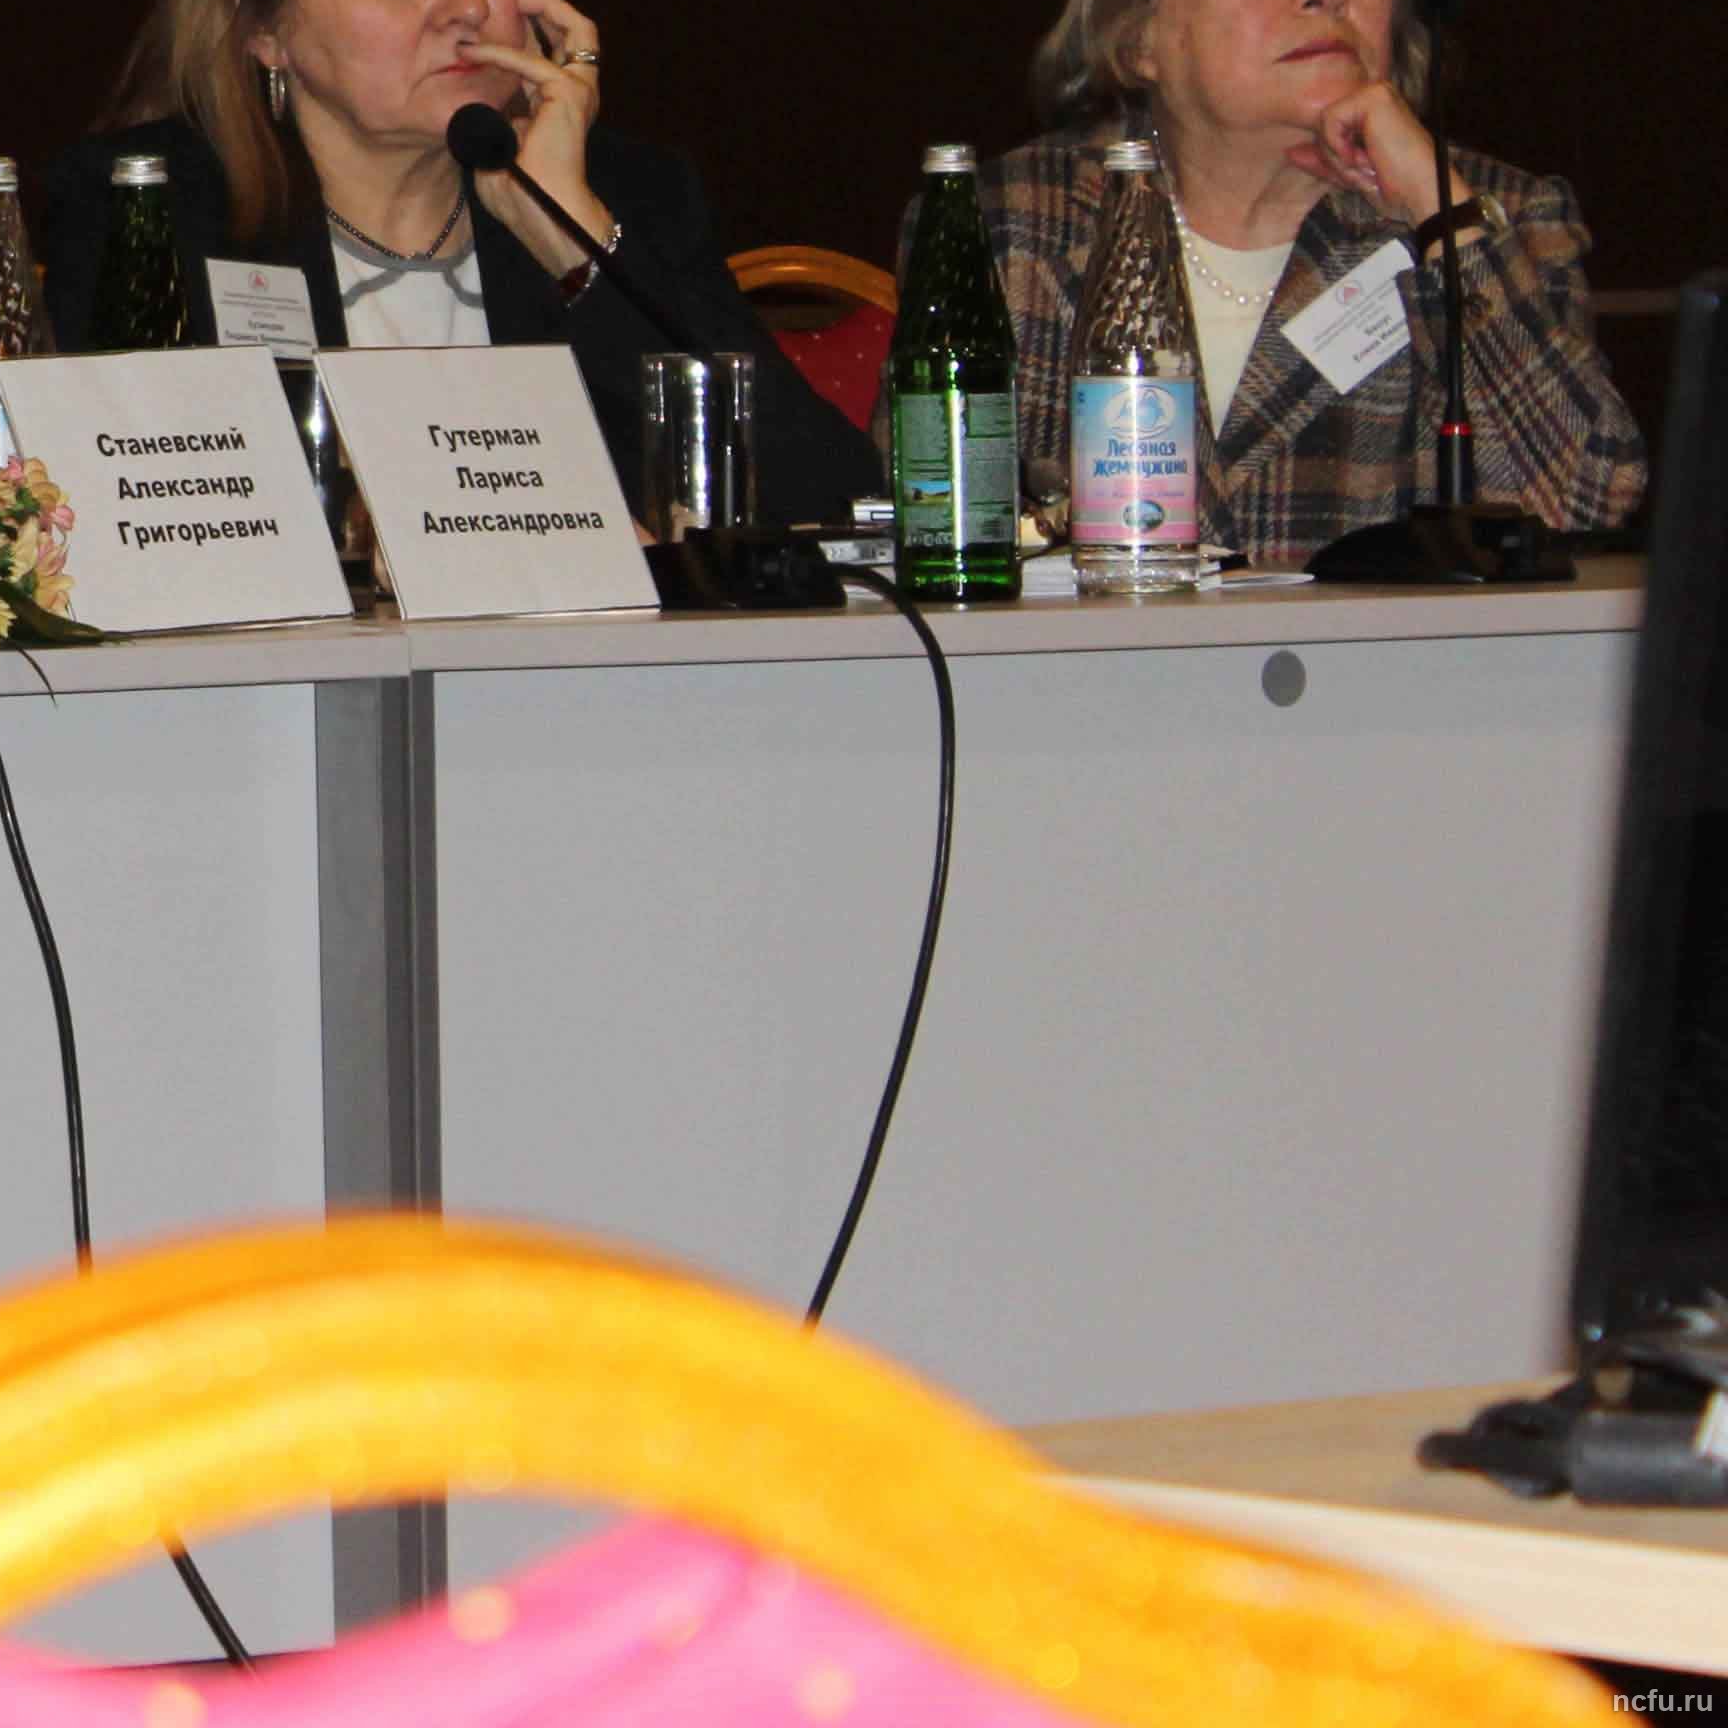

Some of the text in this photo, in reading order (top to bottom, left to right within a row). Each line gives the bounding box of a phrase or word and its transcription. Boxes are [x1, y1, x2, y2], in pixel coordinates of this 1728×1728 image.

[96, 427, 247, 457] Станевский
[427, 424, 542, 453] Гутерман
[117, 475, 256, 500] Александр
[455, 466, 545, 494] Лариса
[117, 518, 280, 551] Григорьевич
[423, 510, 606, 537] Александровна
